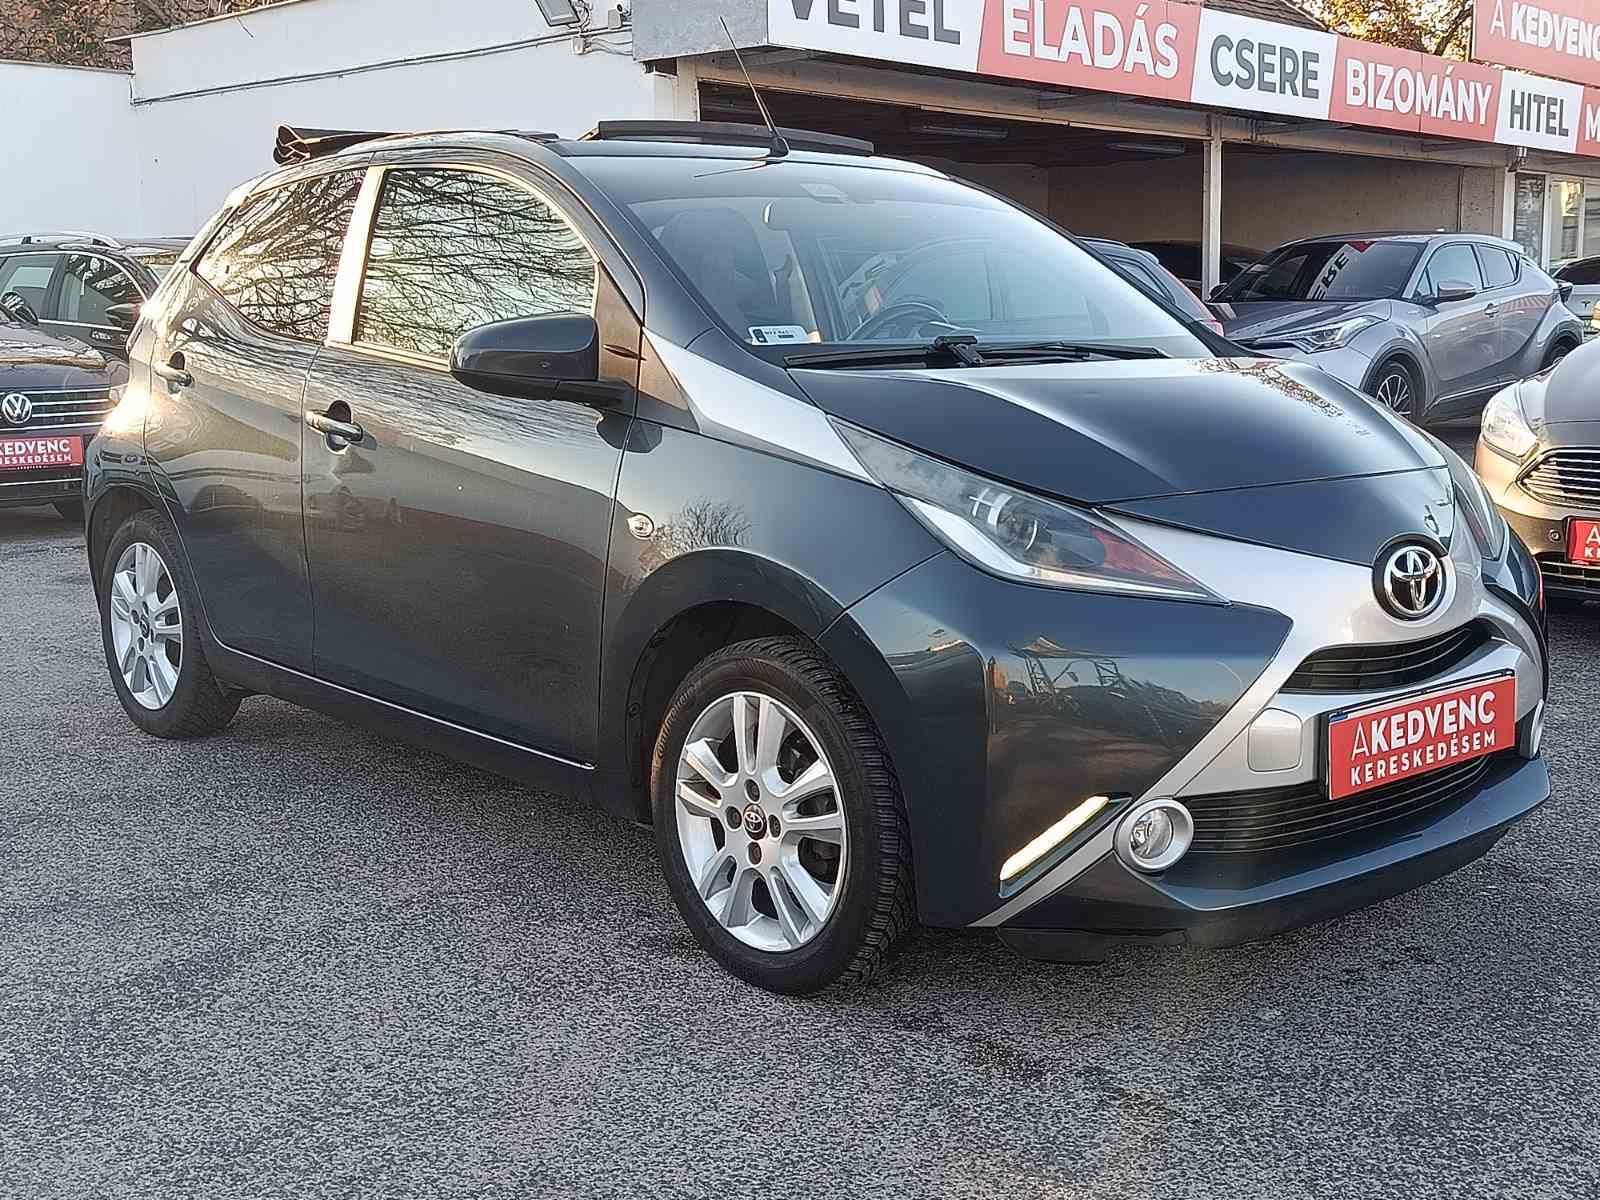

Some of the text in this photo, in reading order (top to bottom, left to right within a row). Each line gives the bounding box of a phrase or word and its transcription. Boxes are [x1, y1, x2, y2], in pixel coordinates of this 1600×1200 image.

[1002, 0, 1179, 79] ELADÁS
[1209, 34, 1320, 99] CSERE
[1345, 58, 1493, 125] BIZOMÁNY
[1509, 89, 1569, 137] HITEL
[1351, 728, 1496, 786] KERESKEDÉSEM
